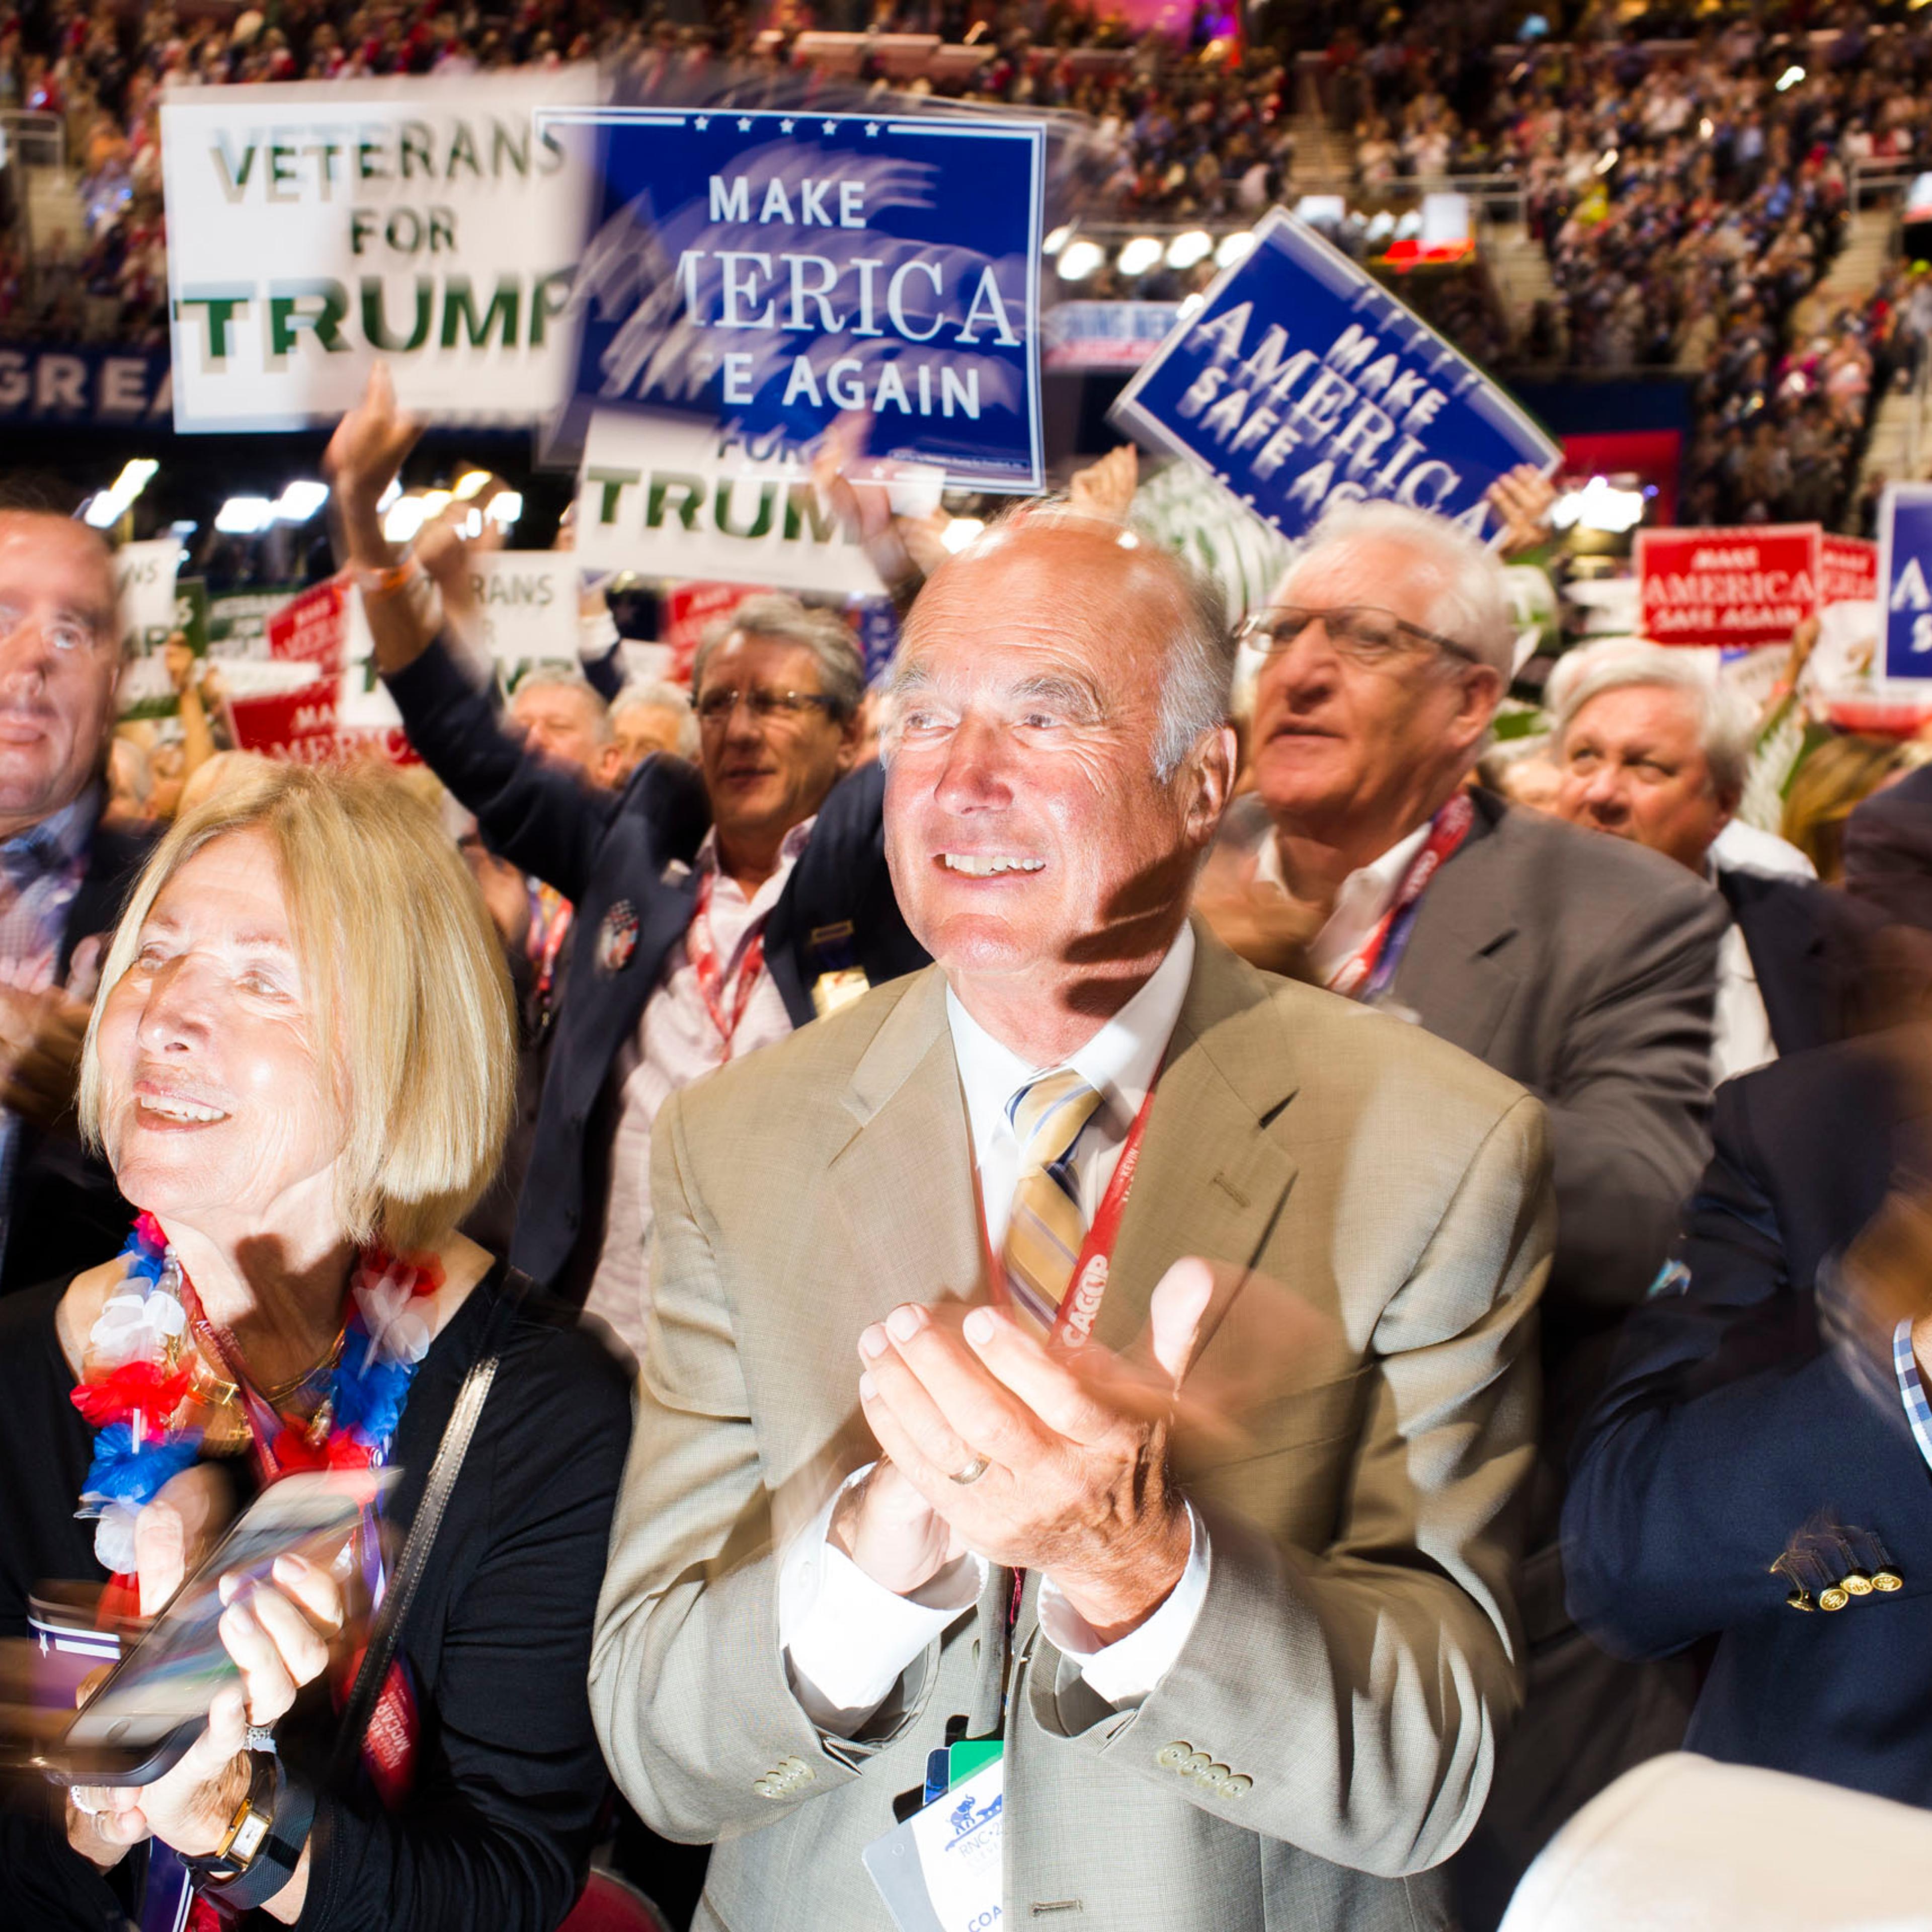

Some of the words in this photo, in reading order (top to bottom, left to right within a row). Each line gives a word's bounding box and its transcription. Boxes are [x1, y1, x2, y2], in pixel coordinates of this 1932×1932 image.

[210, 119, 565, 202] VETERANS
[349, 206, 457, 254] FOR
[709, 175, 866, 228] MAKE
[174, 276, 577, 373] TRUMP
[782, 355, 981, 420] AGAIN
[1322, 323, 1449, 433] MAKE
[1177, 366, 1302, 478] SAFE
[587, 466, 861, 545] TRUM
[469, 574, 553, 605] RANS
[1643, 570, 1814, 605] AMERICA
[1061, 1254, 1108, 1348] CAGOP
[968, 1904, 1002, 1932] COA
